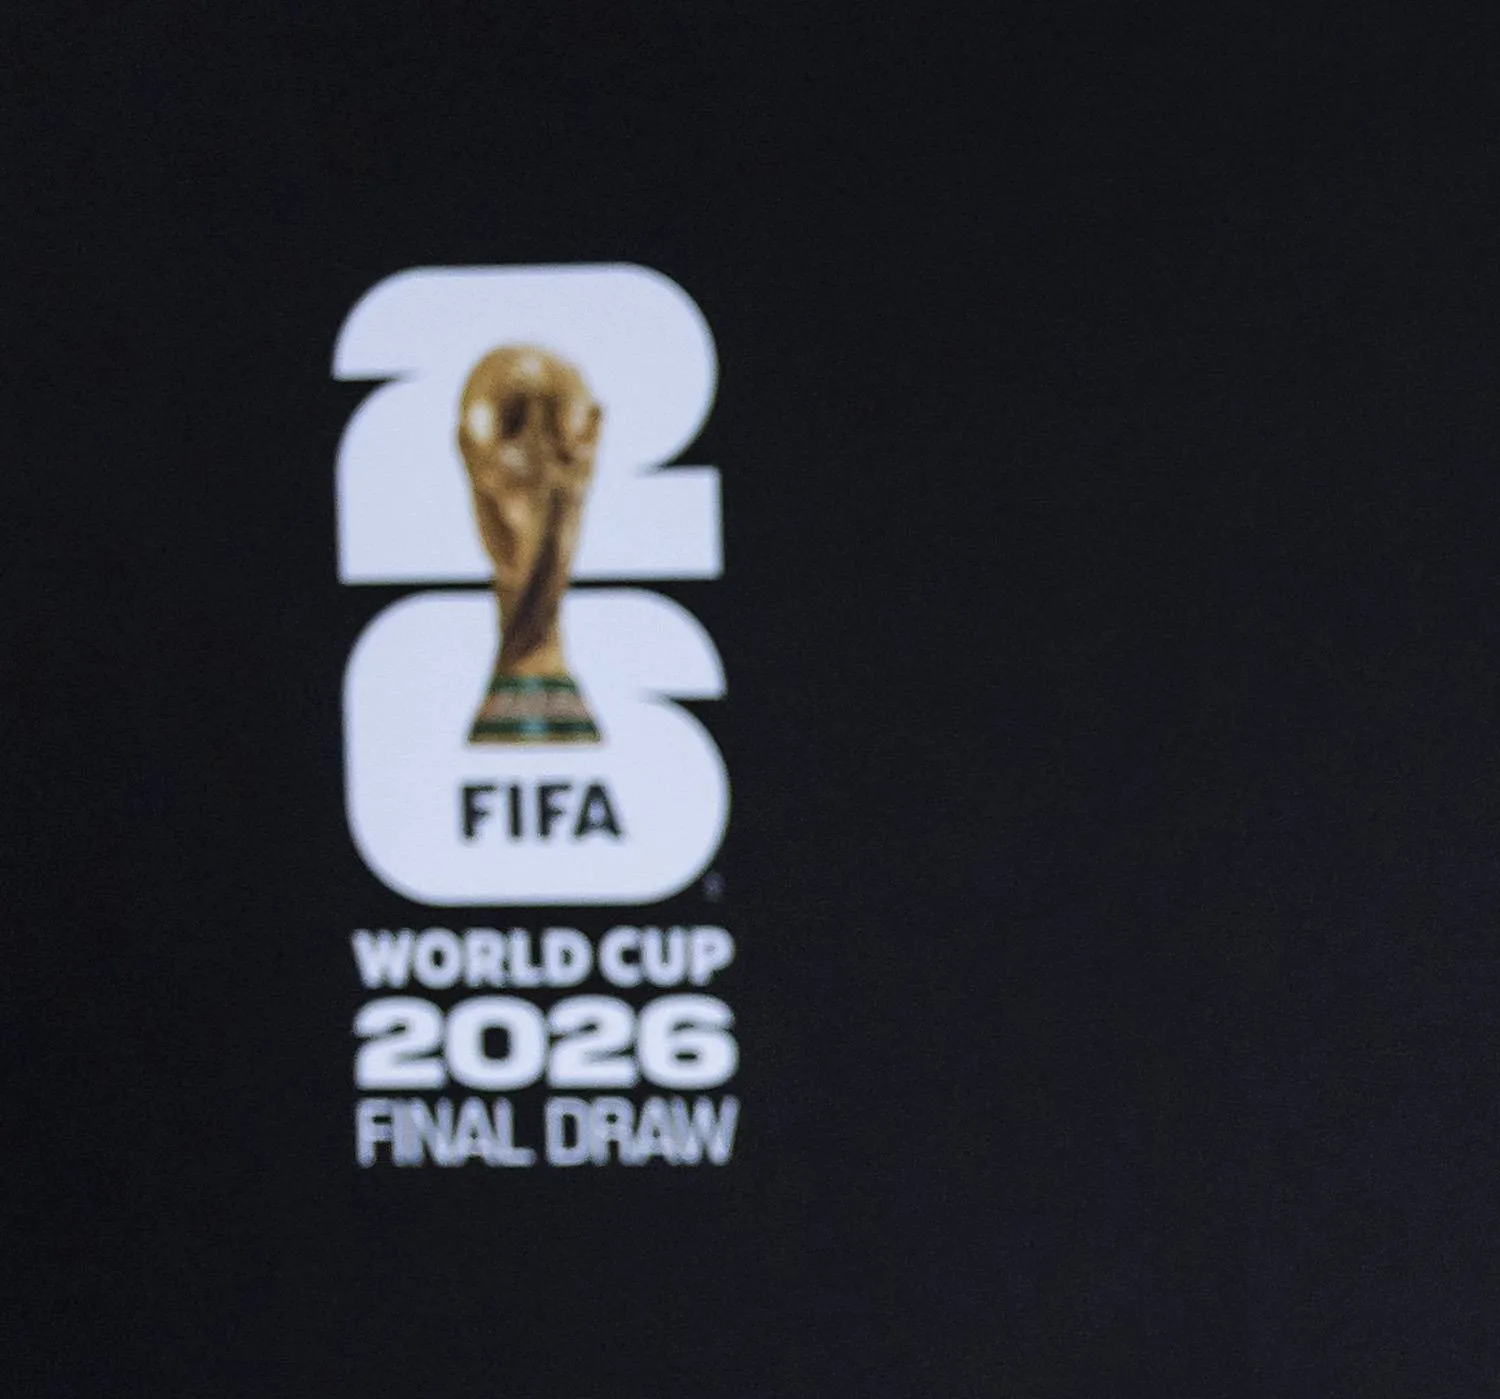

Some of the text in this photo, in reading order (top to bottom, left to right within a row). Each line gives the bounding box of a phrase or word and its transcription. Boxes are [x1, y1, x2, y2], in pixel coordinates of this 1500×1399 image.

[459, 780, 623, 842] FIFA
[351, 925, 735, 989] WORLD CUP
[354, 993, 738, 1091] 2026
[354, 1095, 739, 1168] FINAL DRAW
